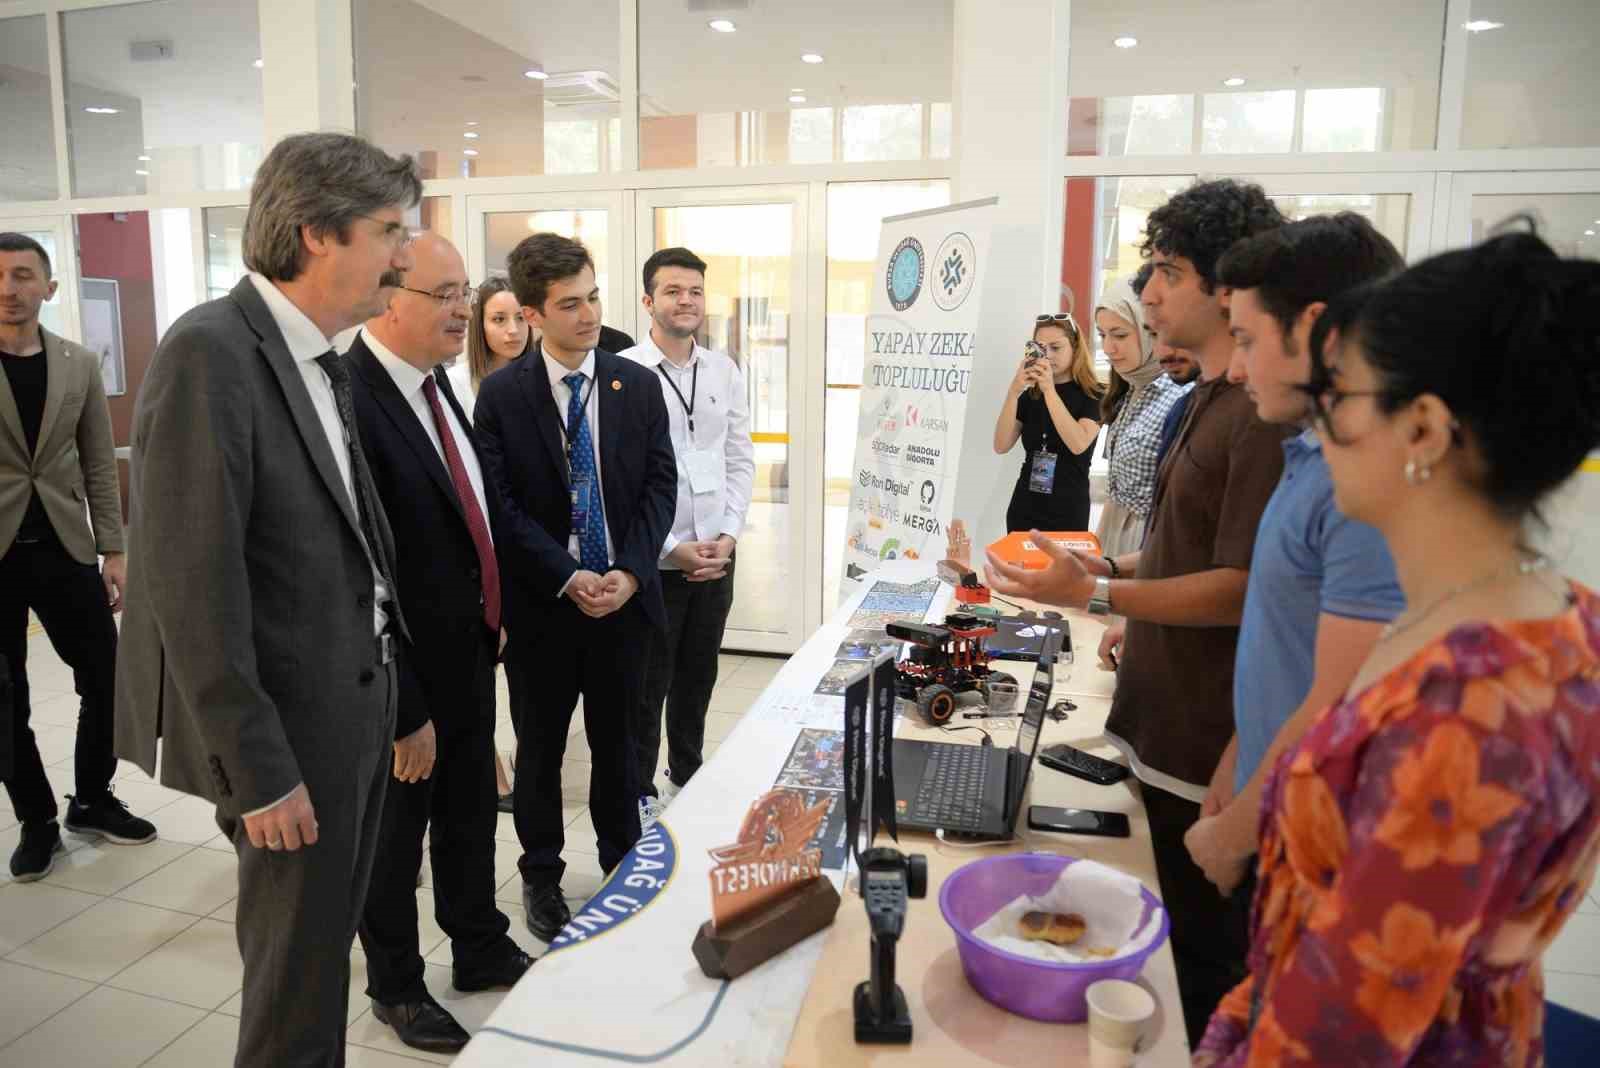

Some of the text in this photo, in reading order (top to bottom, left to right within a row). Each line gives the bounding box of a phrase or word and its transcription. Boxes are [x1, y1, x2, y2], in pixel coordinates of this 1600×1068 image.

[872, 332, 928, 354] YAPAY
[872, 364, 971, 394] TOPLULUĞU
[907, 444, 941, 458] ANADOLU
[885, 479, 910, 496] Digital
